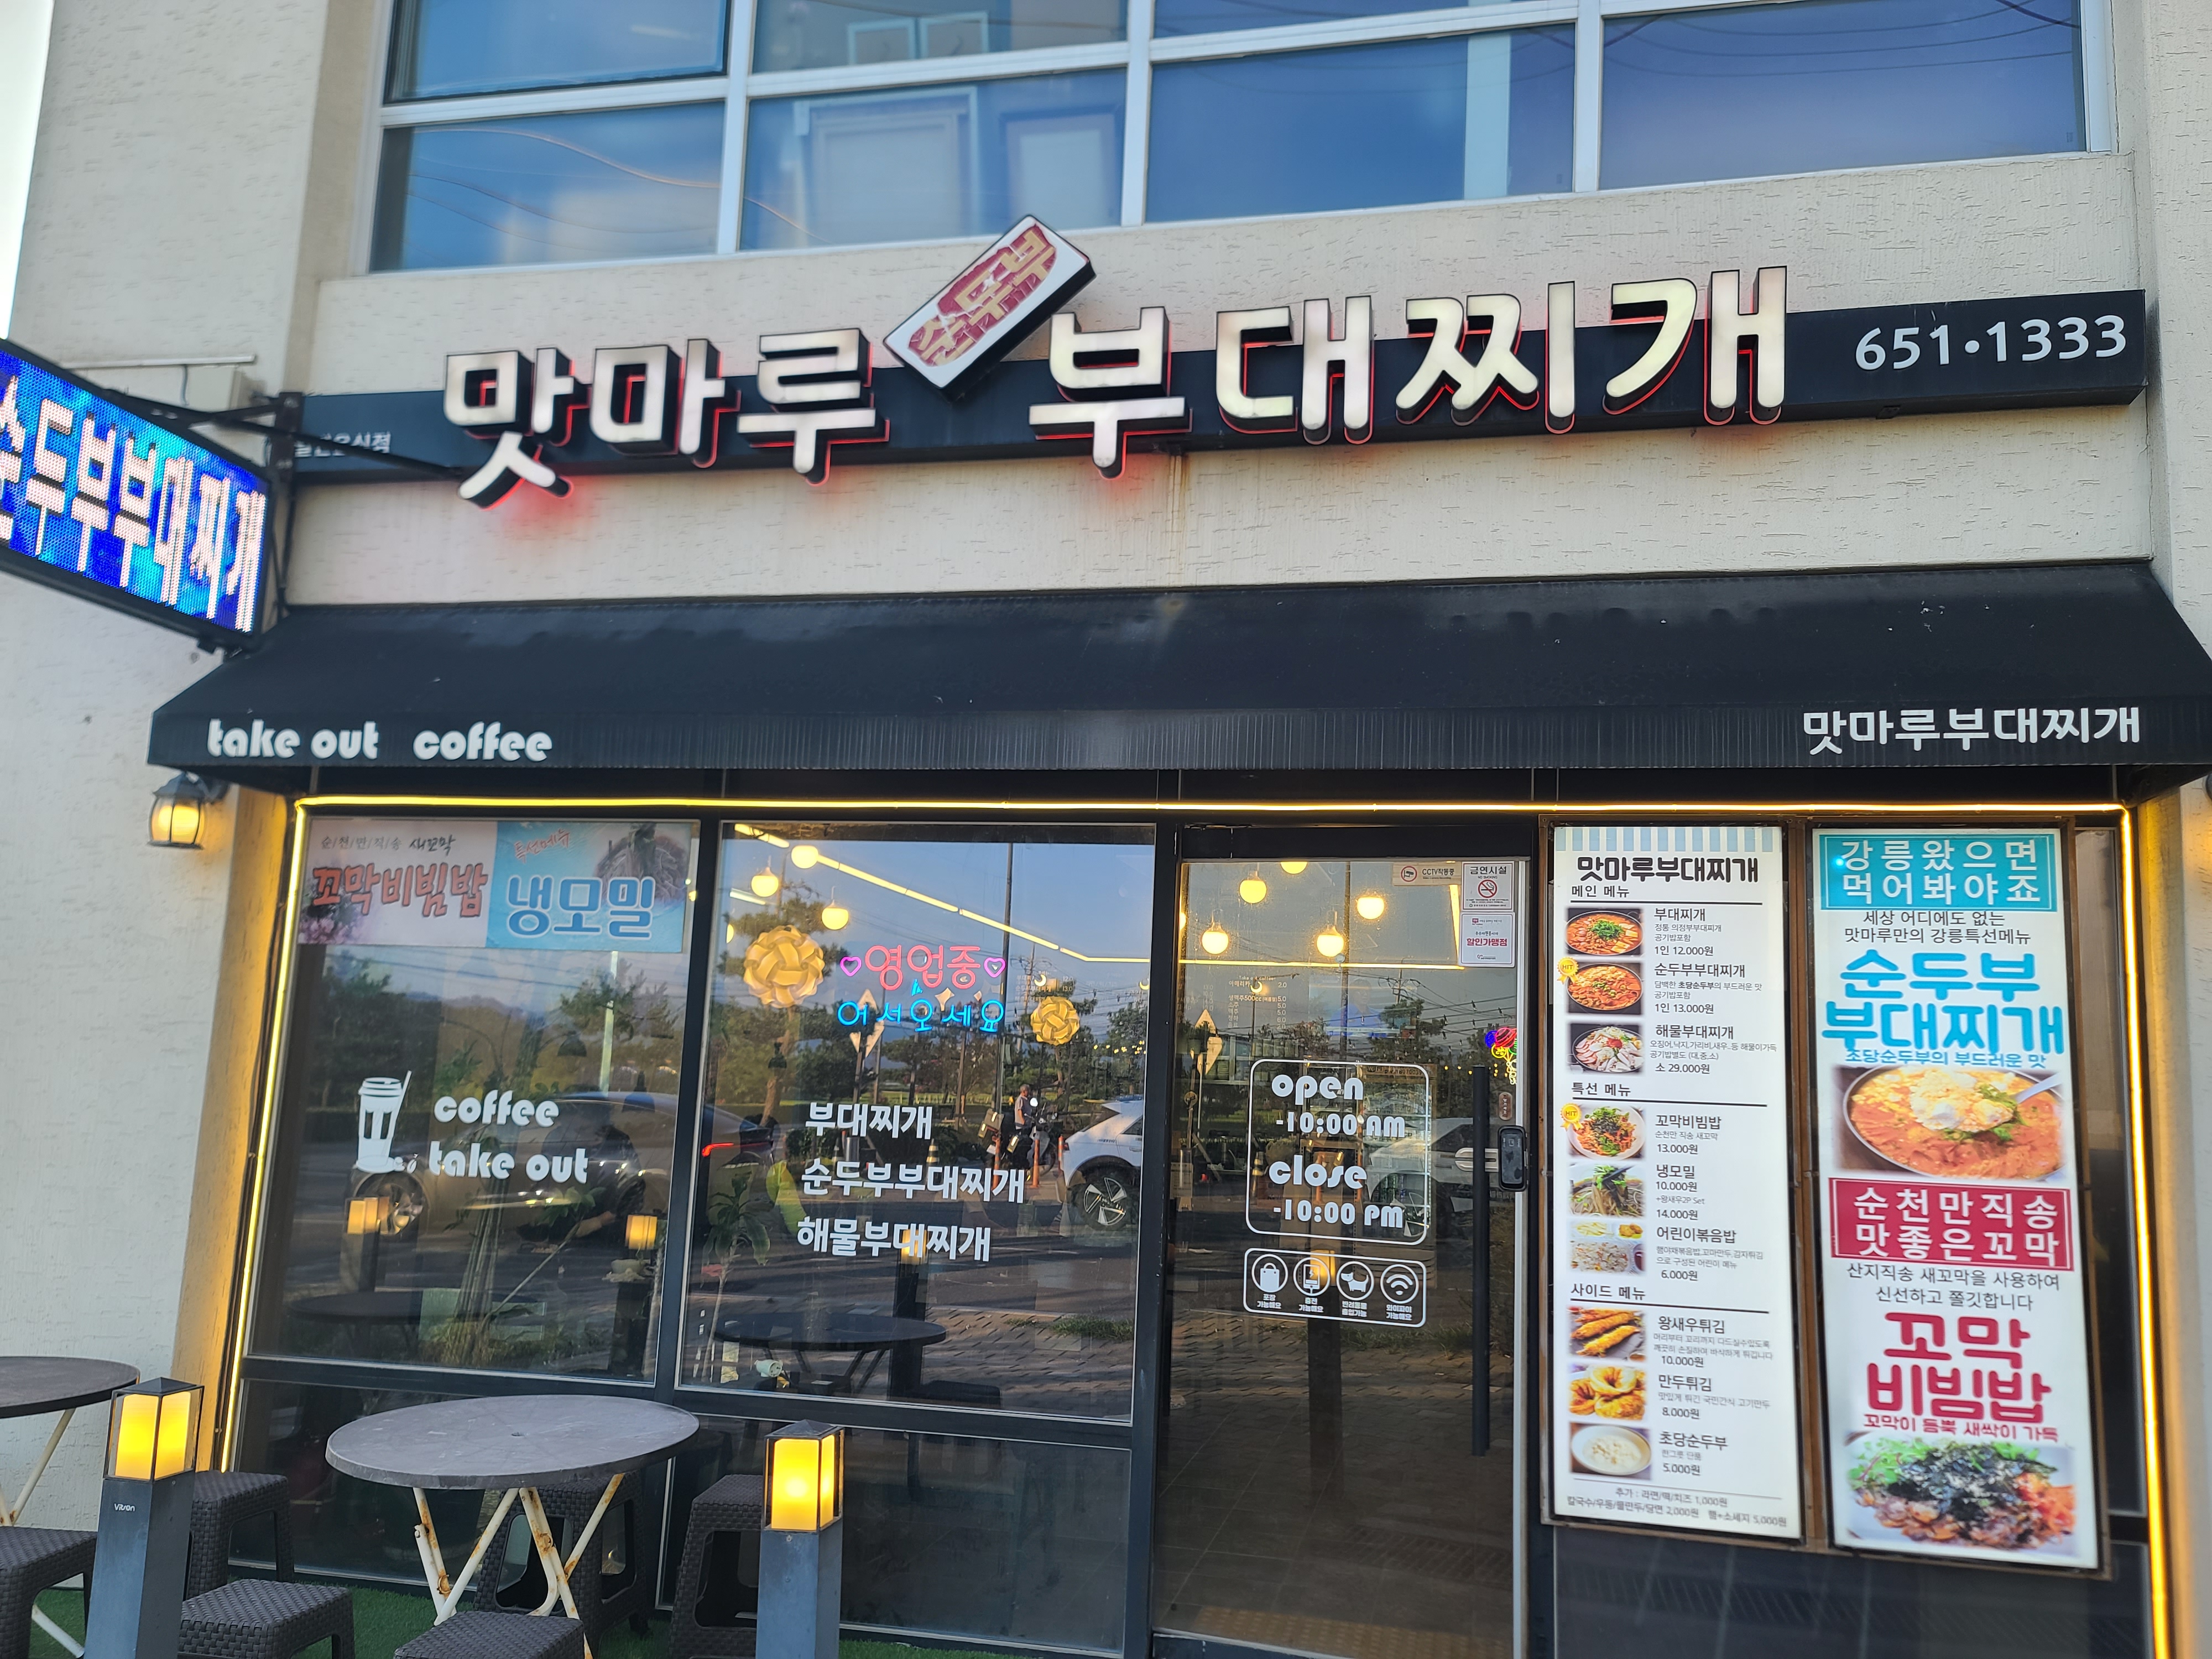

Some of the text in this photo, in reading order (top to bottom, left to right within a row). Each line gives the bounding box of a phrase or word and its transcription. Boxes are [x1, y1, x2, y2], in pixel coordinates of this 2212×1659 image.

[444, 265, 1787, 500] 맛마루 부대찌개
[207, 718, 553, 762] take out coffee
[1803, 707, 2142, 756] 맛마루부대찌개
[409, 834, 456, 856] 새꼬막
[514, 828, 571, 864] 특선메뉴
[1469, 866, 1507, 875] 금연시설
[1577, 856, 1759, 883] 맛마루부대찌개
[312, 862, 488, 918] 꼬막비빔밥
[1571, 885, 1630, 899] 메인 메뉴
[506, 875, 656, 940] 냉모밀
[1653, 907, 1705, 922] 부대찌개
[1863, 911, 2006, 927] 세상 어디에도 없는
[1655, 924, 1721, 932] 정통 의정부부대찌개
[1844, 927, 2031, 945] 맛마루만의 강릉특선메뉴
[1467, 938, 1507, 947] 할인가맹점
[1654, 933, 1691, 942] 공기밥포함
[1654, 945, 1714, 956] 1인 12.000원
[864, 945, 981, 990] 영업중
[1654, 962, 1745, 978] 순두부부대찌개
[1840, 948, 2041, 1002] 순두부
[1654, 980, 1762, 992] 담백한 초당순두부의 부드러운 맛
[1654, 991, 1691, 999] 공기밥포함
[837, 998, 1005, 1033] 어서오세요
[1655, 1003, 1714, 1014] 1인 13.000원
[1655, 1024, 1734, 1040] 해물부대찌개
[1821, 1001, 2065, 1055] 부대찌개
[1650, 1050, 1687, 1059] 공기밥별도
[1954, 1051, 2021, 1068] 부드러운
[2027, 1053, 2046, 1070] 맛
[1655, 1062, 1710, 1074] 소 29.000원
[1271, 1074, 1364, 1106] open
[1571, 1082, 1631, 1097] 특선 메뉴
[434, 1089, 560, 1128] coffee
[805, 1102, 933, 1140] 부대찌개
[1276, 1112, 1405, 1138] -10:00 AM
[1655, 1114, 1721, 1130] 꼬막비빔밥
[1655, 1130, 1718, 1140] 순천만 직송 새꼬막
[1657, 1144, 1698, 1155] 13.000원
[428, 1140, 589, 1184] take out
[1269, 1155, 1368, 1190] close
[1656, 1164, 1695, 1180] 냉모밀
[801, 1158, 1025, 1204] 순두부부대찌개
[1656, 1181, 1697, 1192] 10.000원
[1273, 1199, 1404, 1229] -10:00 PM
[1656, 1209, 1698, 1220] 14.000원
[797, 1215, 992, 1262] 해물부대찌개
[1657, 1226, 1737, 1244] 어린이볶음밥
[1673, 1258, 1695, 1266] 구성된
[1698, 1259, 1720, 1267] 어린이
[1722, 1261, 1738, 1269] 메뉴
[1661, 1270, 1698, 1281] 6.000원
[1846, 1262, 2059, 1291] 산지직송 새꼬막을 사용하여
[1262, 1293, 1276, 1302] 포장
[1571, 1284, 1646, 1301] 사이드 메뉴
[1875, 1286, 2033, 1312] 신선하고 쫄깃합니다
[1256, 1300, 1282, 1310] 가능해요
[1298, 1304, 1324, 1313] 가능해요
[1386, 1304, 1413, 1313] 와이파이
[1386, 1312, 1413, 1321] 가능해요
[1658, 1316, 1725, 1334] 왕새우튀김
[1653, 1333, 1683, 1343] 머리부터
[1882, 1311, 2031, 1369] 꼬막
[1661, 1355, 1704, 1368] 10.000원
[1658, 1374, 1712, 1392] 만두튀김
[1866, 1362, 2052, 1425] 비빔밥
[1863, 1413, 1917, 1433] 꼬막이
[1963, 1422, 2017, 1439] 새싹이
[2022, 1425, 2059, 1443] 가득
[1659, 1431, 1729, 1451] 초당순두부
